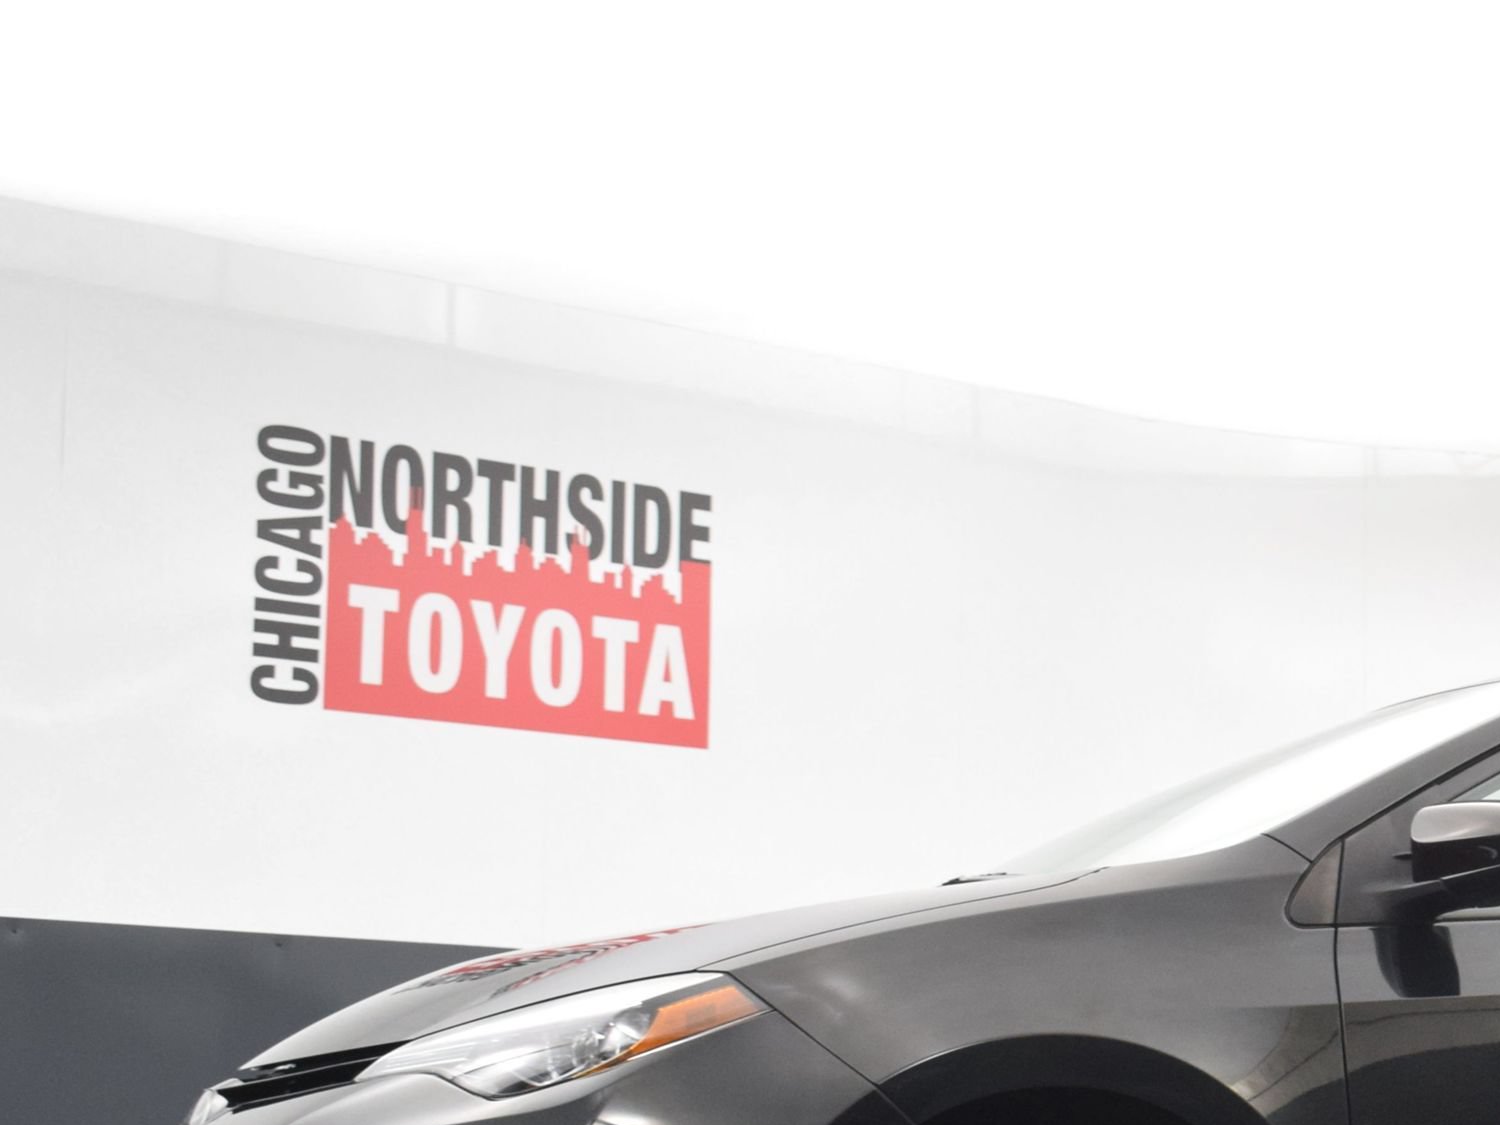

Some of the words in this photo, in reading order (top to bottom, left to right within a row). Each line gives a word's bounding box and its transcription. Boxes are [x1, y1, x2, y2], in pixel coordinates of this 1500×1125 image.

[250, 424, 326, 705] CHICAGO
[329, 435, 712, 570] NORTHSIDE
[348, 583, 695, 720] TOYOTA
